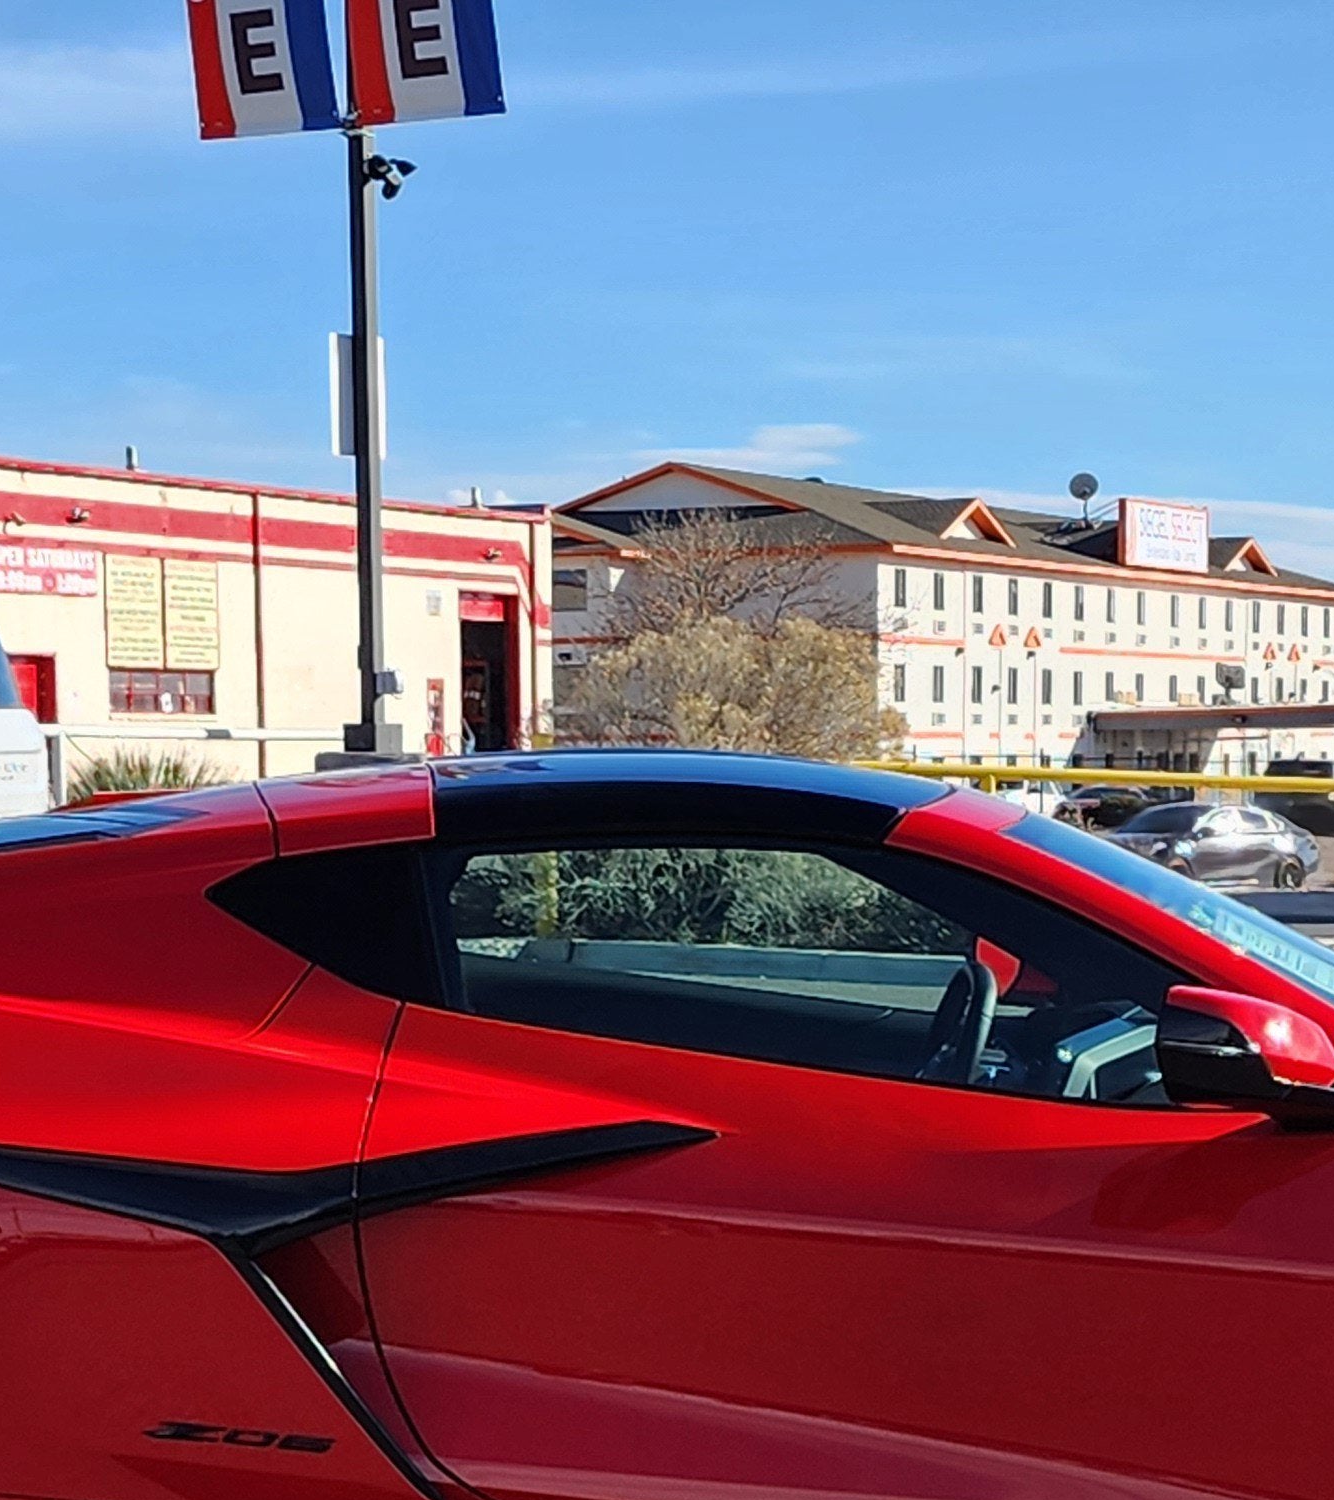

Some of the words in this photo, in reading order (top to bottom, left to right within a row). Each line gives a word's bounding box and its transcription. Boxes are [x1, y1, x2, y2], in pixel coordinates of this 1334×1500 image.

[230, 9, 285, 95] E
[393, 0, 450, 80] E
[27, 548, 96, 571] SATURDAYS
[142, 1421, 337, 1454] Z06
